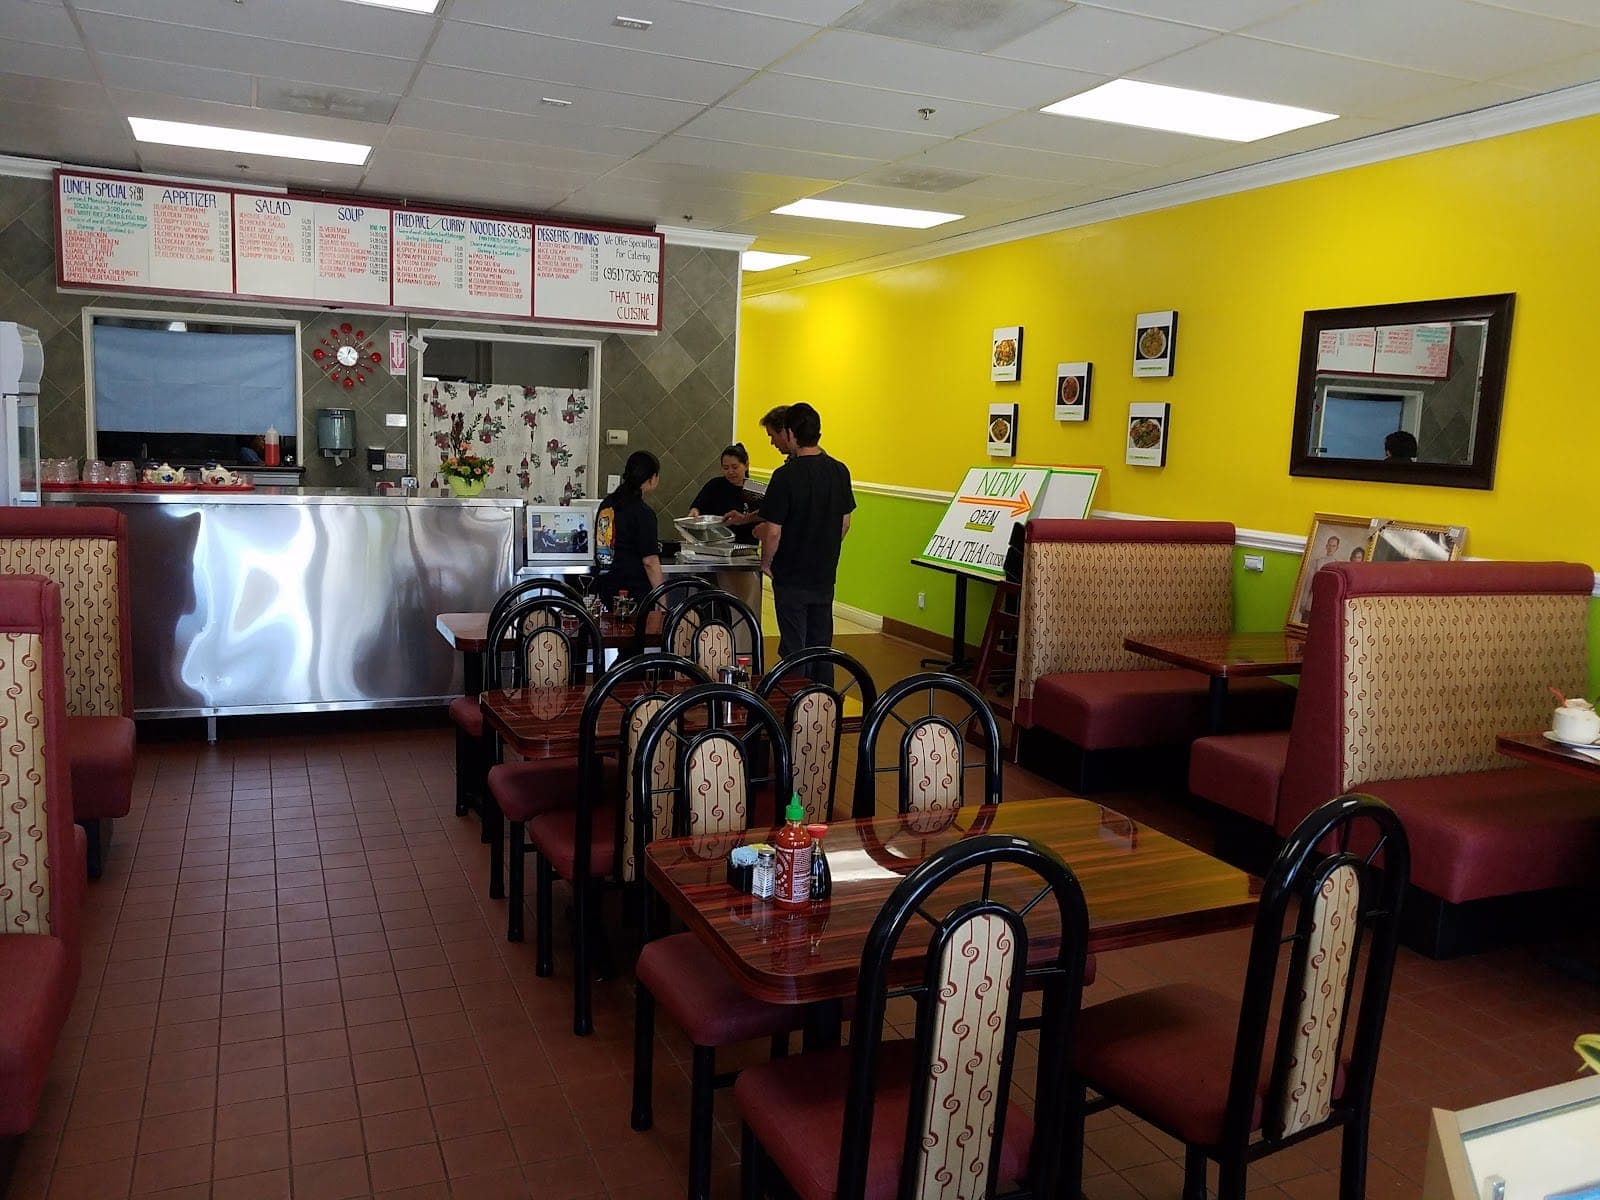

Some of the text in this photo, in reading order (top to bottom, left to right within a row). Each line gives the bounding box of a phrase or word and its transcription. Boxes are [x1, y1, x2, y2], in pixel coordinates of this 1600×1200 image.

[63, 177, 91, 195] LUNCH
[96, 183, 127, 200] SPECIAL
[161, 189, 217, 208] APPETIZER
[255, 199, 292, 216] SALAD
[337, 206, 364, 222] SOUP
[441, 217, 466, 233] CURRY
[469, 220, 507, 237] NOODLES
[507, 224, 532, 240] $8.99
[537, 227, 570, 243] DESSERTS
[574, 231, 600, 246] DRINKS
[604, 234, 614, 245] We
[614, 235, 628, 246] Offer
[628, 237, 648, 249] Special
[615, 248, 651, 264] For Catering
[609, 290, 654, 306] THAI THAI
[616, 306, 650, 321] CUISINE
[975, 471, 1026, 498] NOW
[969, 509, 1001, 526] OPEN
[928, 534, 961, 560] THAI
[958, 540, 990, 565] THAI
